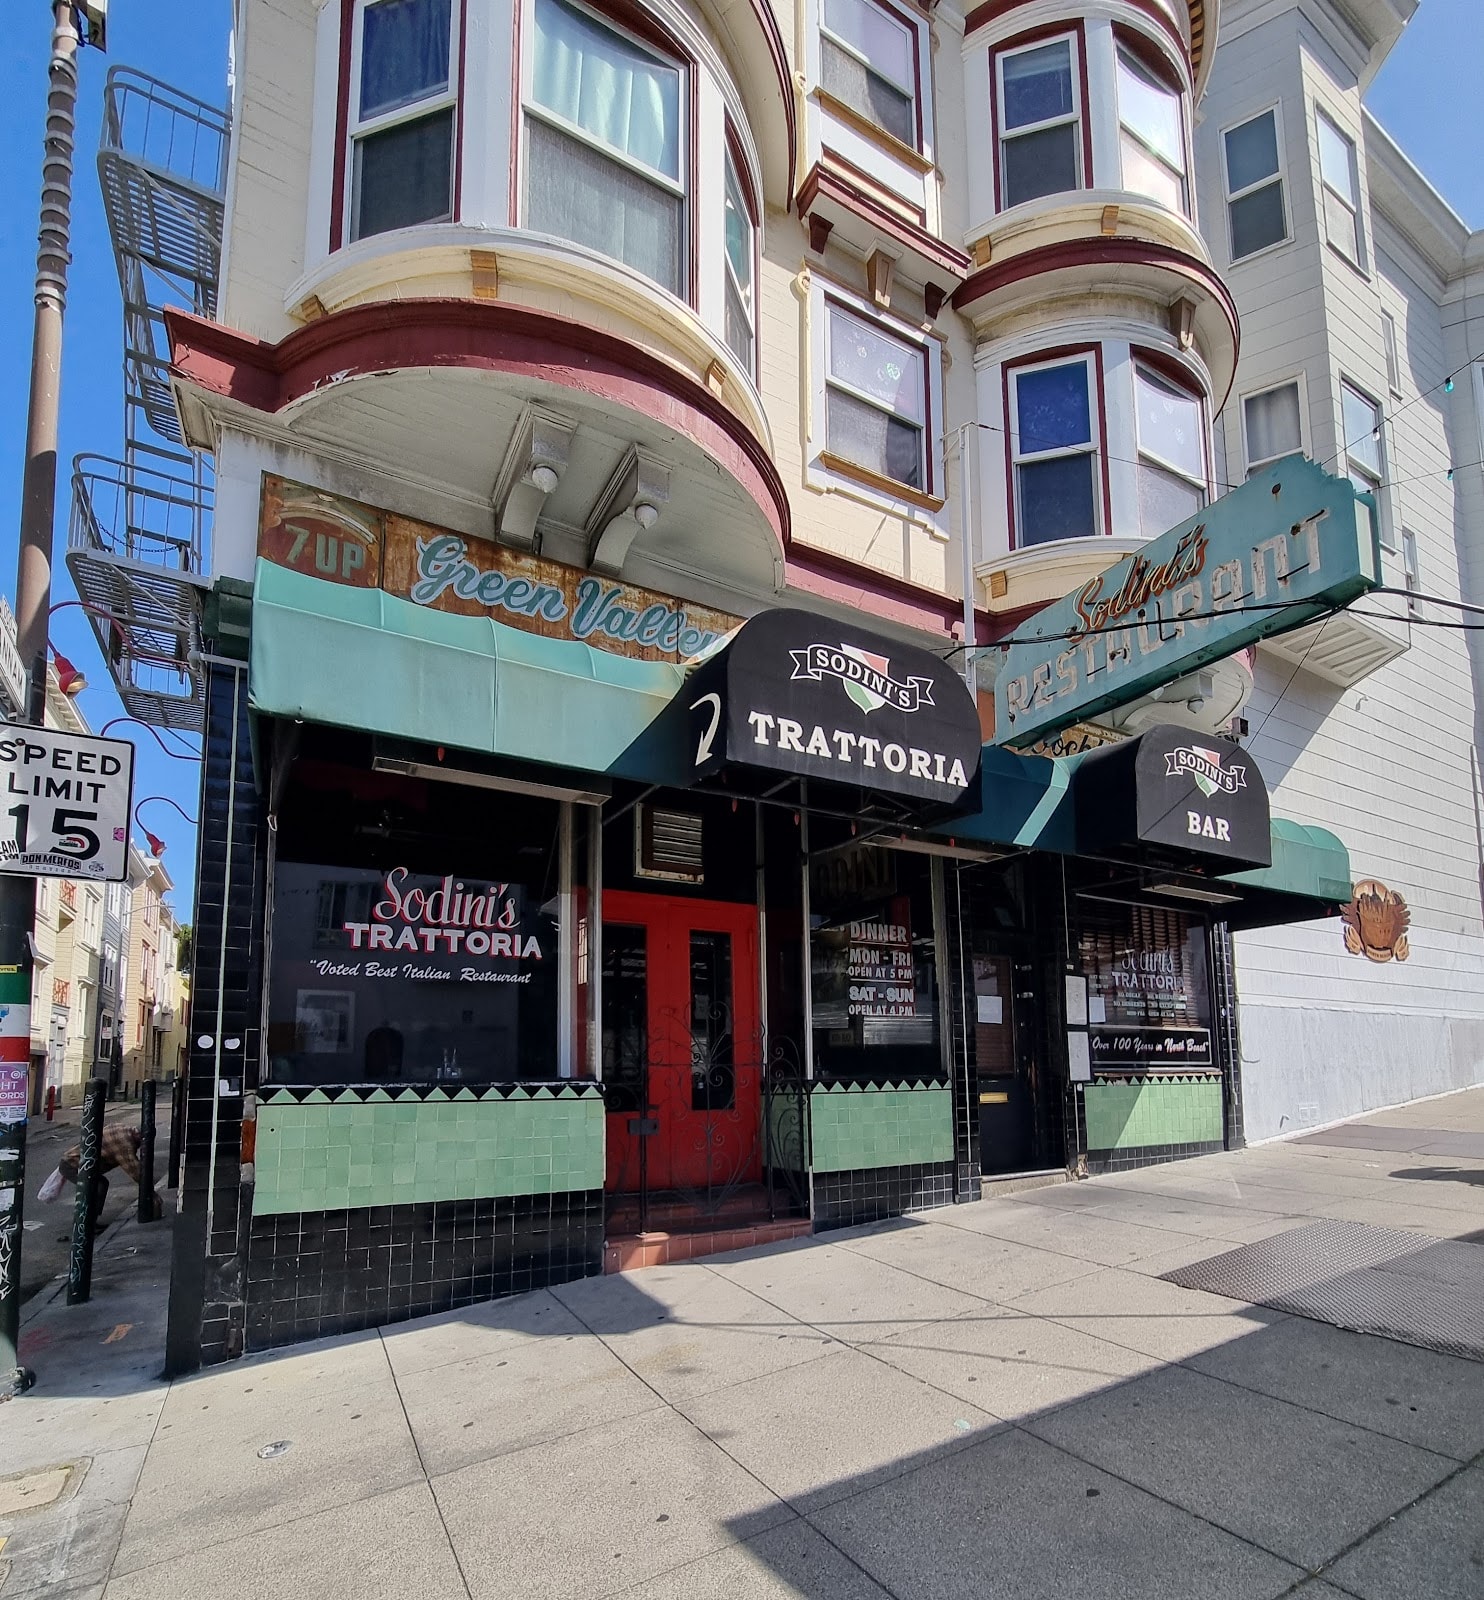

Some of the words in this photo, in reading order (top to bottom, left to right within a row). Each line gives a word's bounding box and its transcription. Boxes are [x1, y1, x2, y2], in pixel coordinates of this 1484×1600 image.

[411, 534, 569, 622] Green
[1064, 523, 1209, 643] Sodini's
[1007, 508, 1330, 716] RESTAURANT
[815, 648, 911, 708] SODINI'S
[0, 740, 121, 776] SPEED
[748, 710, 969, 787] TRATTORIA
[1178, 749, 1234, 790] SODINI'S
[8, 772, 106, 804] LIMIT
[8, 803, 101, 861] 15
[1186, 810, 1231, 842] BAR
[372, 866, 521, 929] Sodini's
[343, 921, 543, 960] TRATTORIA
[850, 921, 908, 943] DINNER
[364, 962, 398, 978] Best
[402, 963, 452, 980] Italian
[459, 967, 532, 984] Restaurant
[848, 965, 872, 977] OPEN
[875, 966, 886, 978] AT
[890, 967, 896, 979] 5
[898, 968, 912, 979] PM
[850, 948, 879, 966] MON
[892, 950, 911, 967] FRI
[849, 986, 876, 1002] SAT
[886, 987, 914, 1003] SUN
[849, 1005, 873, 1016] OPEN
[876, 1005, 887, 1016] AT
[899, 1006, 913, 1017] PM
[1113, 1037, 1132, 1050] 100
[1133, 1037, 1154, 1054] Years
[1164, 1038, 1185, 1053] North
